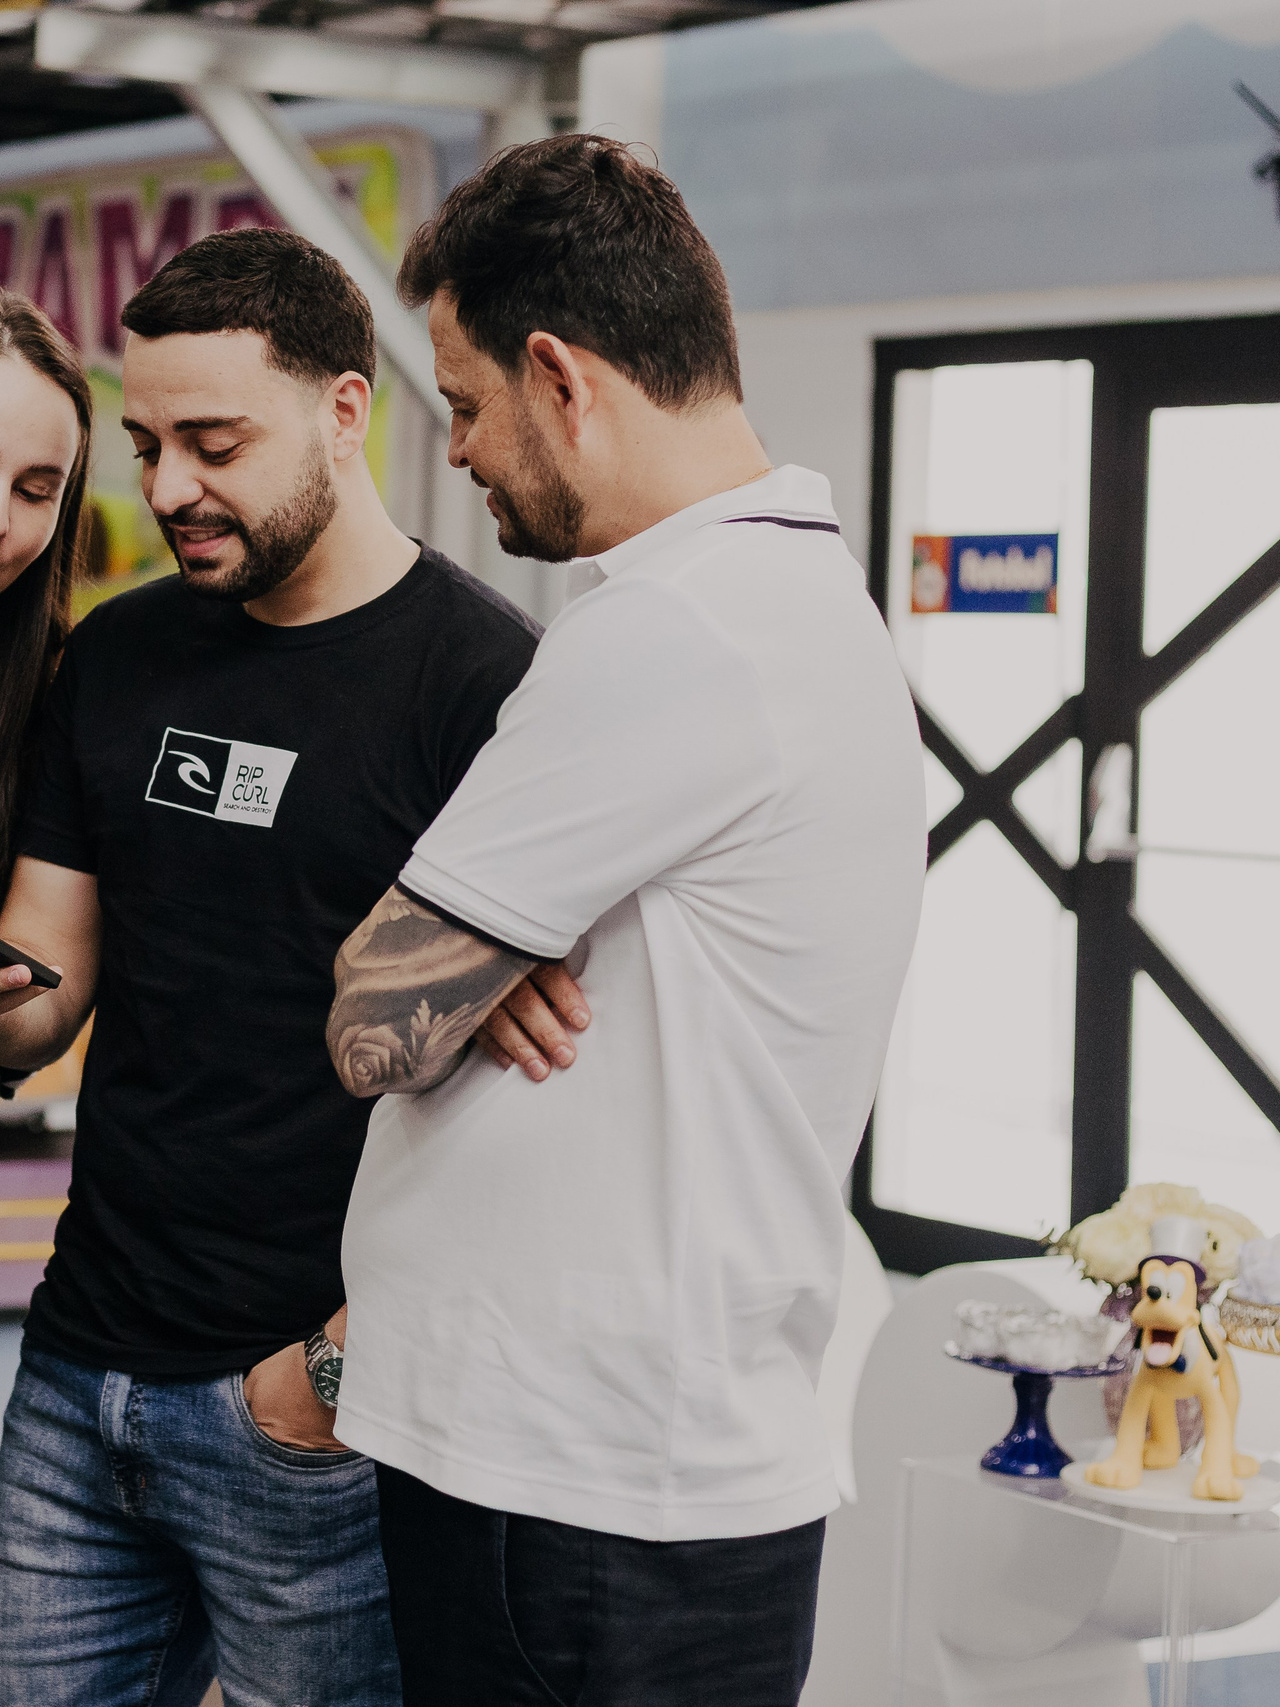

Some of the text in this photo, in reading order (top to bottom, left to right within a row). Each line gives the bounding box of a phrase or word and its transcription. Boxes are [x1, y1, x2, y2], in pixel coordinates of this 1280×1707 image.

[235, 764, 264, 783] RIP
[232, 783, 269, 804] CURL
[251, 806, 272, 814] DESTROY
